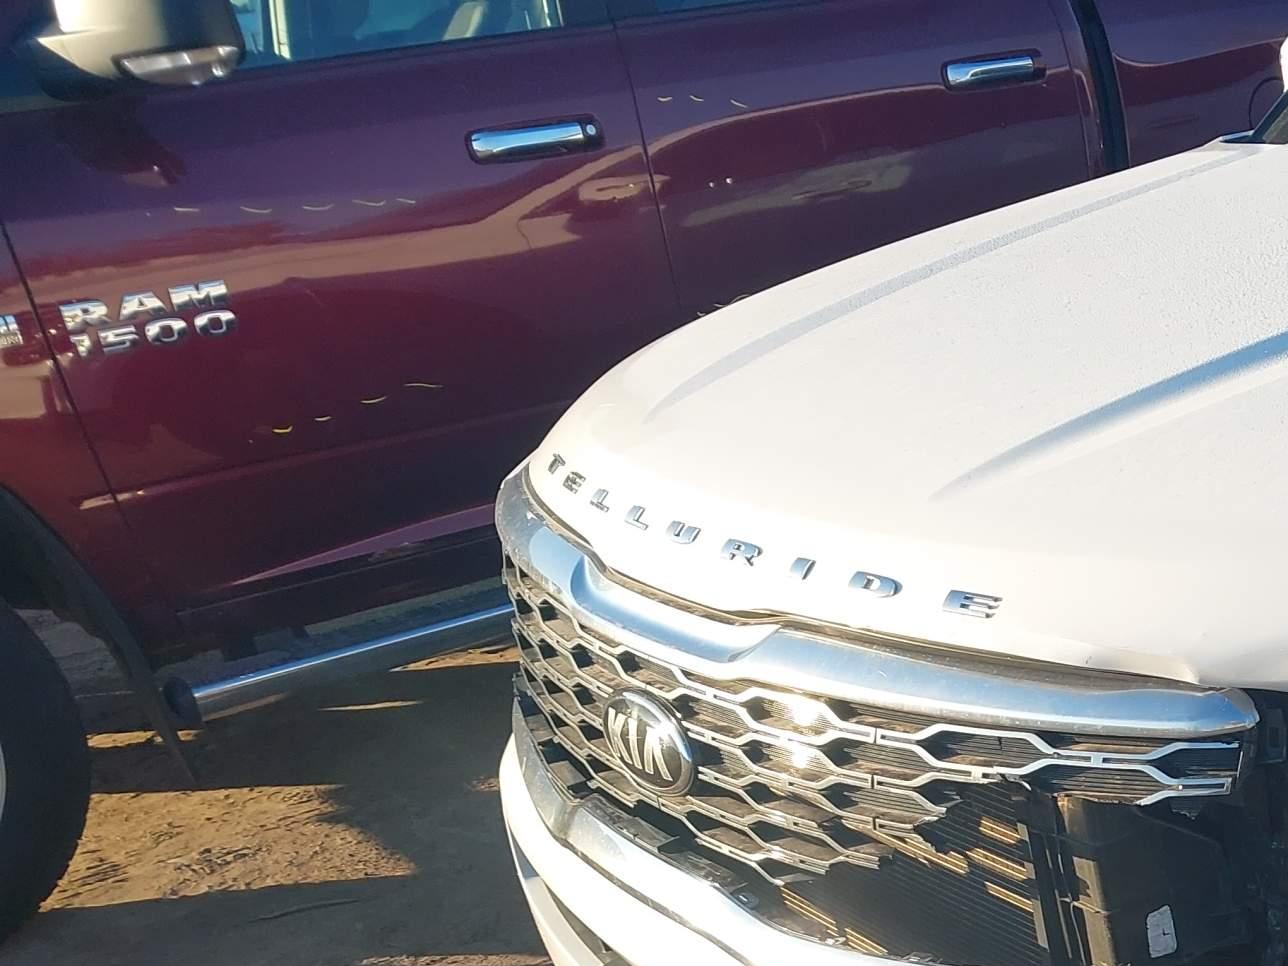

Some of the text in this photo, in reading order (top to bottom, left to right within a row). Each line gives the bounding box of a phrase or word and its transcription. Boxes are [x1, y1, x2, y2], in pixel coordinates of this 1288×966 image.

[58, 280, 229, 331] RAM
[70, 309, 237, 357] 1500
[547, 453, 1004, 619] TELLURIDE
[607, 706, 674, 782] KIA
